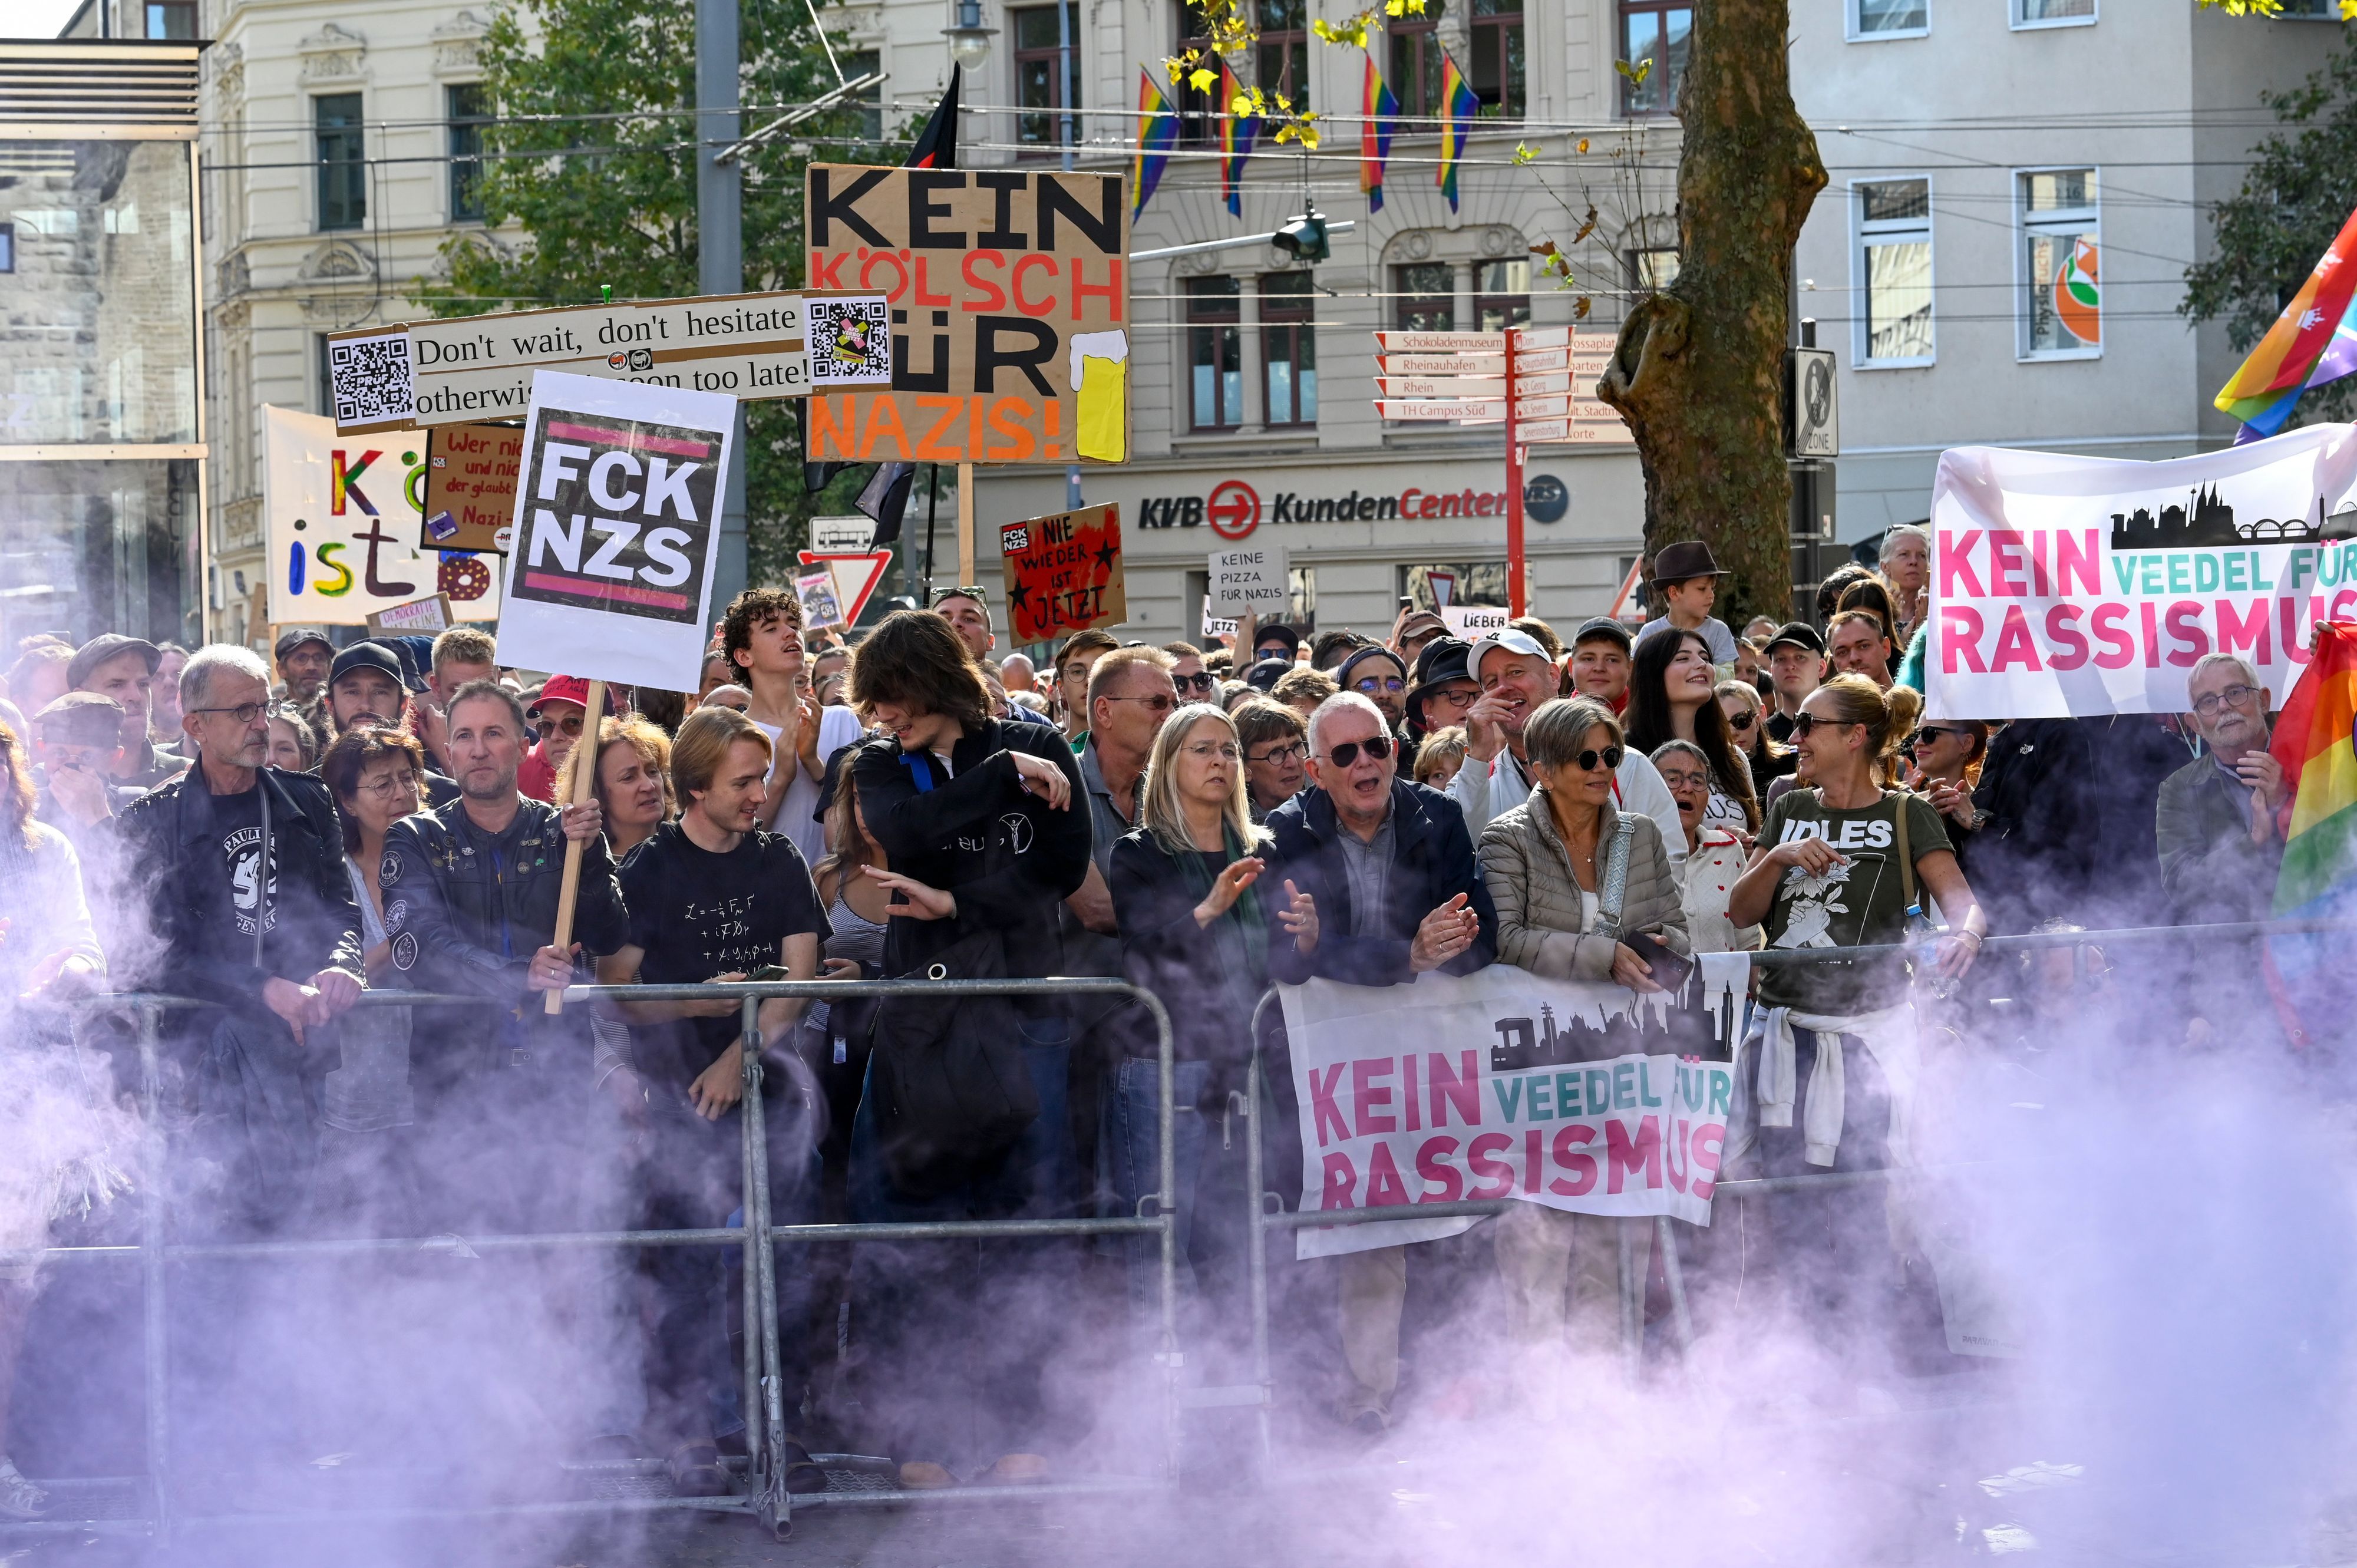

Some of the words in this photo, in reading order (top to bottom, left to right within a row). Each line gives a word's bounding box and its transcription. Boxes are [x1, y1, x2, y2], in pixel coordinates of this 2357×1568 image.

[810, 169, 1123, 254] KEIN
[811, 246, 1122, 322] KÖLSCH
[416, 334, 496, 365] Don't
[511, 326, 582, 355] wait,
[598, 315, 669, 345] don't
[685, 308, 796, 337] hesitate
[1404, 336, 1503, 348] Schokoladenmuseum
[1523, 336, 1534, 346] Dom
[892, 309, 1058, 397] ÜR
[1523, 354, 1557, 369] Hauptbahnhof
[694, 370, 738, 391] too
[747, 358, 810, 388] late!
[1404, 359, 1475, 371] Rheinauhafen
[356, 373, 389, 388] PRÜF
[1404, 382, 1433, 392] Rhein
[1531, 380, 1546, 393] Georg
[1402, 405, 1416, 415] TH
[1420, 405, 1463, 418] Campus
[1465, 404, 1485, 415] Süd
[1531, 401, 1548, 412] Severin
[811, 394, 1059, 460] NAZIS!
[447, 433, 491, 454] Wer
[1808, 433, 1829, 450] ZONE
[465, 460, 492, 475] und
[445, 477, 469, 493] der
[470, 480, 511, 498] glaubt
[537, 441, 702, 521] FCK
[1138, 496, 1203, 529] KVB
[1003, 528, 1027, 542] FCK
[1042, 516, 1074, 546] NIE
[527, 509, 692, 587] NZS
[1003, 538, 1028, 552] NZS
[289, 519, 415, 597] ist
[1021, 543, 1088, 570] WIEDER
[1222, 552, 1264, 566] KEINE
[1939, 529, 2101, 598] KEIN
[2111, 551, 2274, 595] VEEDEL
[2290, 539, 2357, 589] FÜR
[1051, 570, 1072, 589] IST
[1221, 572, 1262, 585] PIZZA
[1222, 589, 1242, 601] FÜR
[1245, 587, 1282, 601] NAZIS
[383, 601, 434, 623] DEMOKRATIE
[1034, 585, 1107, 629] JETZT
[1780, 818, 1893, 849] IDLES
[379, 876, 398, 886] LONDON
[1308, 1049, 1481, 1148] KEIN
[1492, 1062, 1662, 1124] VEEDEL
[1321, 1115, 1727, 1230] RASSISMUS
